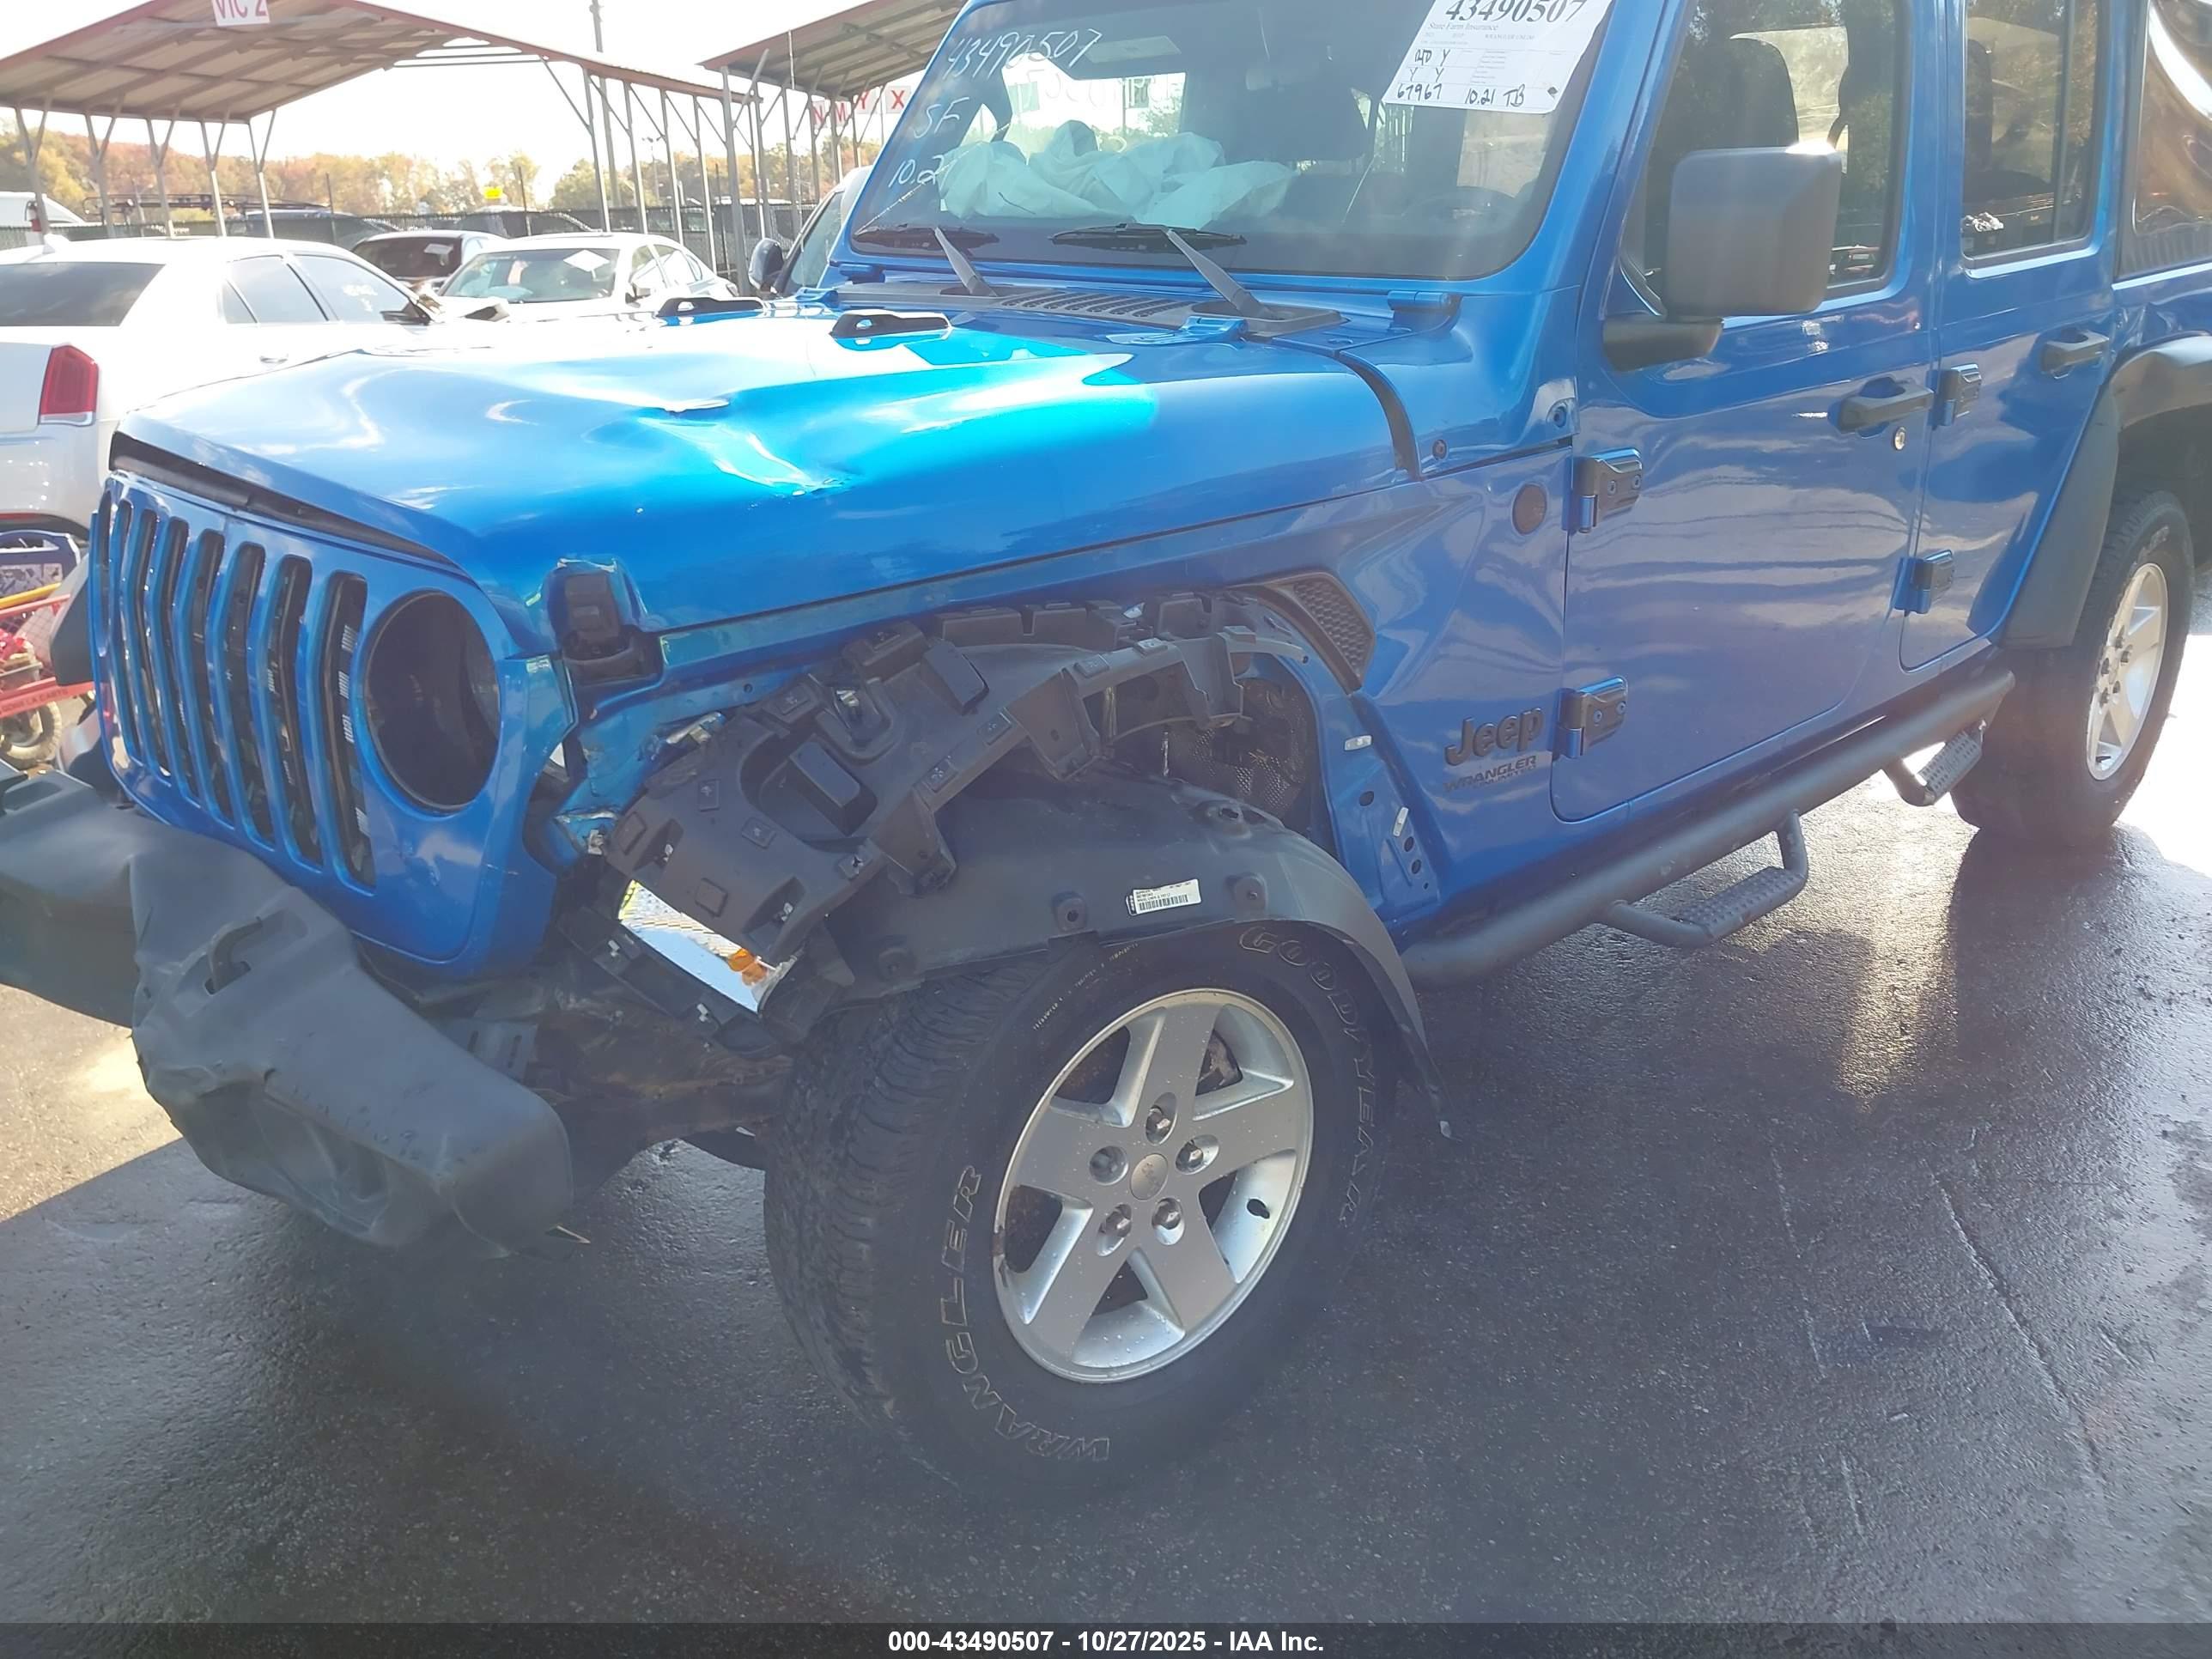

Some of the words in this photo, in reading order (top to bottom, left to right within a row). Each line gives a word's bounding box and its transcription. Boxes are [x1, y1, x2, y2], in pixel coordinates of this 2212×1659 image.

[1445, 0, 1589, 22] 43490507
[942, 28, 1103, 81] 43490507
[890, 89, 905, 110] X
[1444, 708, 1544, 766] Jeep
[1443, 755, 1537, 793] WRANGLER
[940, 1164, 1110, 1462] WRANGLER
